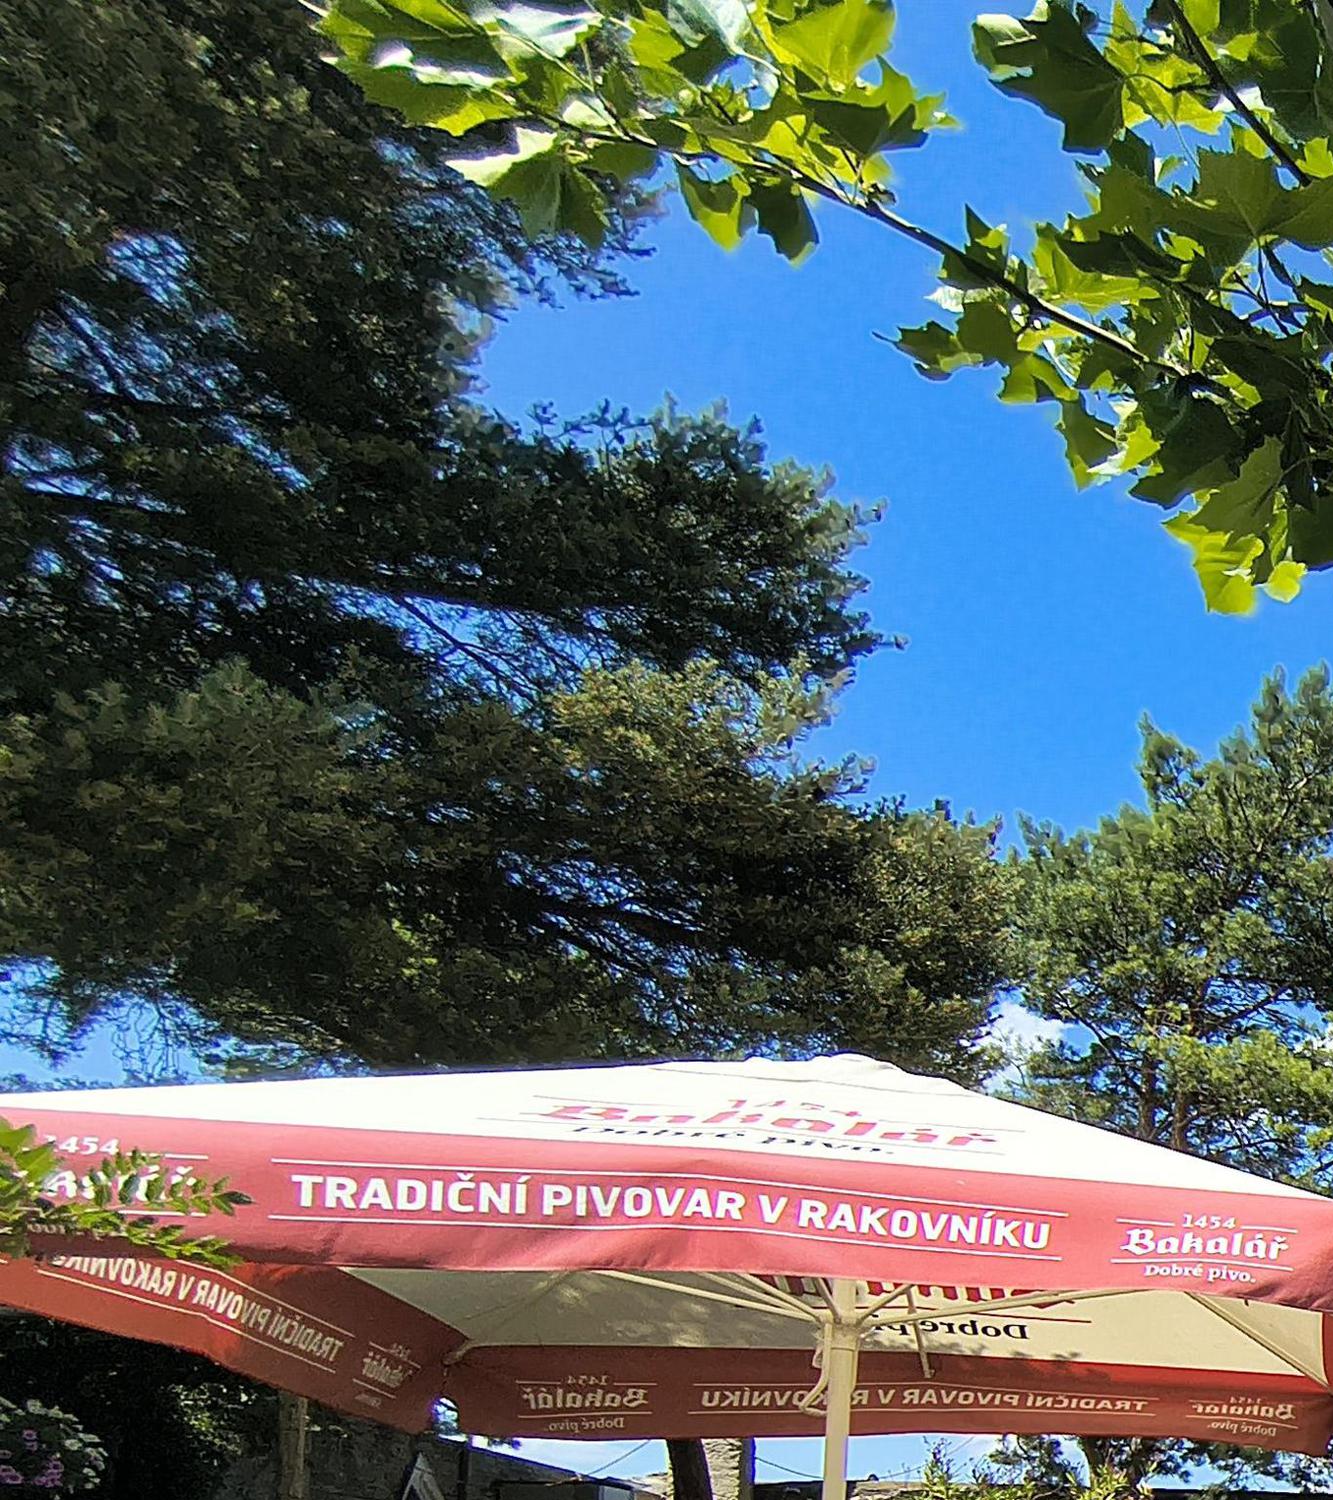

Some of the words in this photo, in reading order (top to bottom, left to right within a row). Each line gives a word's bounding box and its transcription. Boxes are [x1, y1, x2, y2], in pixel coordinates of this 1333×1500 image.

[547, 1104, 998, 1147] Bakalář
[291, 1172, 532, 1215] TRADIČNÍ
[542, 1183, 747, 1221] PIVOVAR
[757, 1195, 789, 1225] V
[798, 1199, 1051, 1250] RAKOVNÍKU
[1182, 1213, 1237, 1230] 1454
[1119, 1227, 1290, 1260] Bakalář
[1144, 1262, 1203, 1278] Dobré
[1206, 1266, 1257, 1284] pivo.
